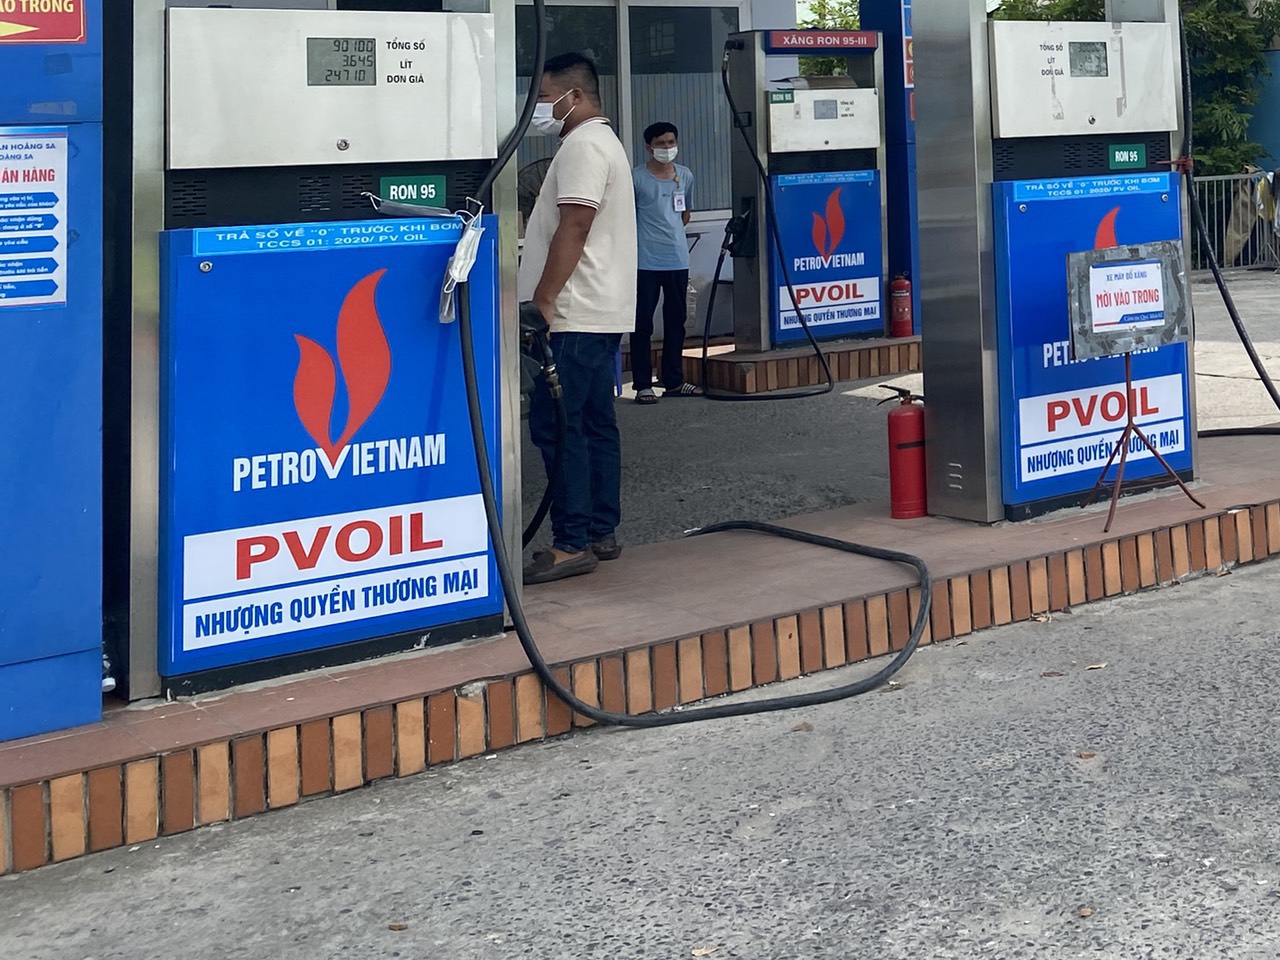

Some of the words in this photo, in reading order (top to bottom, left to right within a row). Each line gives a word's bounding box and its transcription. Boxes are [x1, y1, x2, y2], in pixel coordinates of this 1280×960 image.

[386, 37, 411, 50] TỔNG
[413, 38, 426, 50] SỐ
[783, 33, 813, 46] XĂNG
[816, 35, 840, 46] RON
[842, 36, 867, 46] 95-III
[1115, 151, 1129, 162] RON
[1130, 151, 1138, 161] 95
[2, 167, 19, 183] ÁN
[22, 166, 56, 183] HÀNG
[389, 185, 418, 200] RON
[420, 184, 436, 198] 95
[216, 230, 250, 240] TRẢ
[255, 227, 280, 239] SỐ
[340, 222, 394, 234] TRƯỚC
[400, 223, 426, 232] KHI
[256, 239, 301, 249] TCCS
[378, 235, 402, 243] PV
[404, 234, 428, 242] OIL
[794, 252, 865, 271] PETROVIETNAM
[795, 283, 864, 305] PVOIL
[1096, 290, 1111, 308] MỜI
[1114, 288, 1130, 305] VÀO
[1132, 289, 1160, 304] TRONG
[1047, 386, 1159, 432] PVOIL
[1027, 449, 1074, 473] NHƯỢNG
[1077, 438, 1112, 464] QUYỀN
[1159, 429, 1179, 449] MẠI
[232, 433, 446, 491] PETROVIETNAM
[235, 512, 443, 581] PVOIL
[195, 603, 283, 639] NHƯỢNG
[289, 586, 355, 622] QUYỀN
[361, 577, 437, 612] THƯƠNG
[443, 568, 479, 597] MẠI
